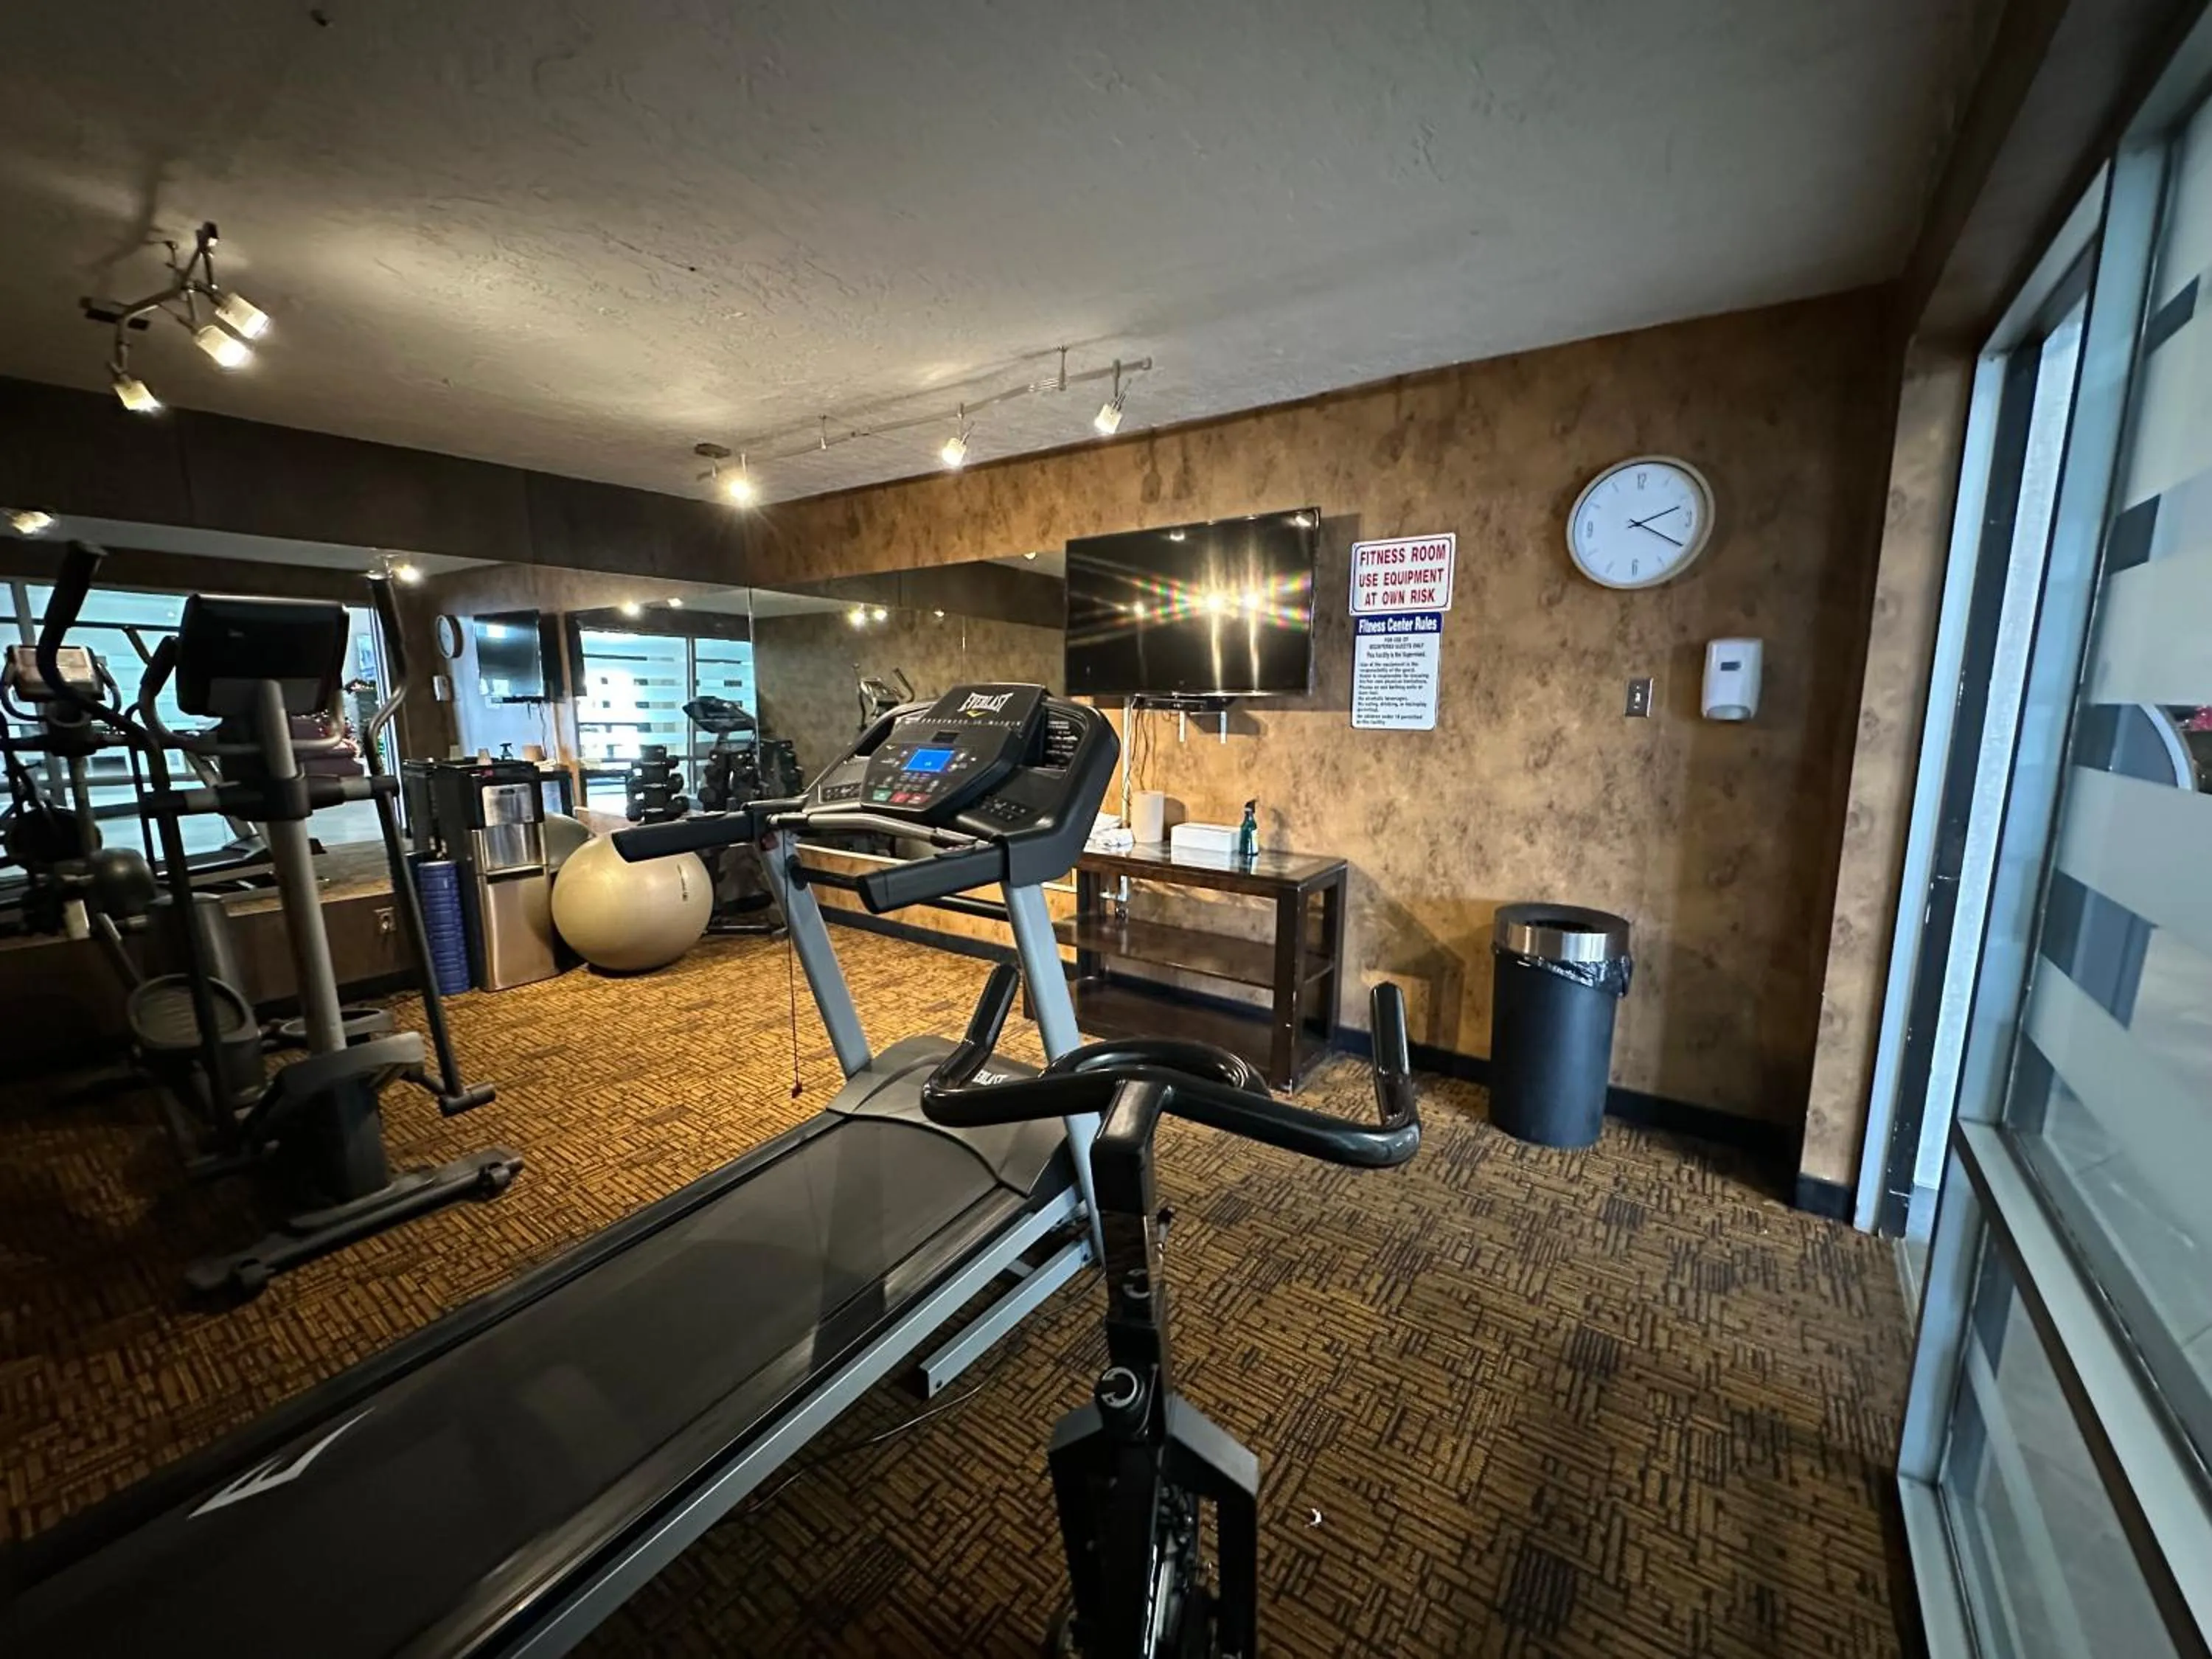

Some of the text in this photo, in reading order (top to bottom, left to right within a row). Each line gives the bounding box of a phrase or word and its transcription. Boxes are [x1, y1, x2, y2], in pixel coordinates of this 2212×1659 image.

[1637, 473, 1647, 490] 12
[1586, 521, 1594, 538] 9
[1359, 543, 1446, 567] FITNESS ROOM
[1631, 559, 1640, 576] 6
[1359, 568, 1444, 588] USE EQUIPMENT
[1365, 588, 1436, 606] AT OWN RISK
[1359, 616, 1437, 633] Fitness Center Rules
[957, 692, 1015, 713] EVERLAST
[971, 1069, 1009, 1086] ERLAST
